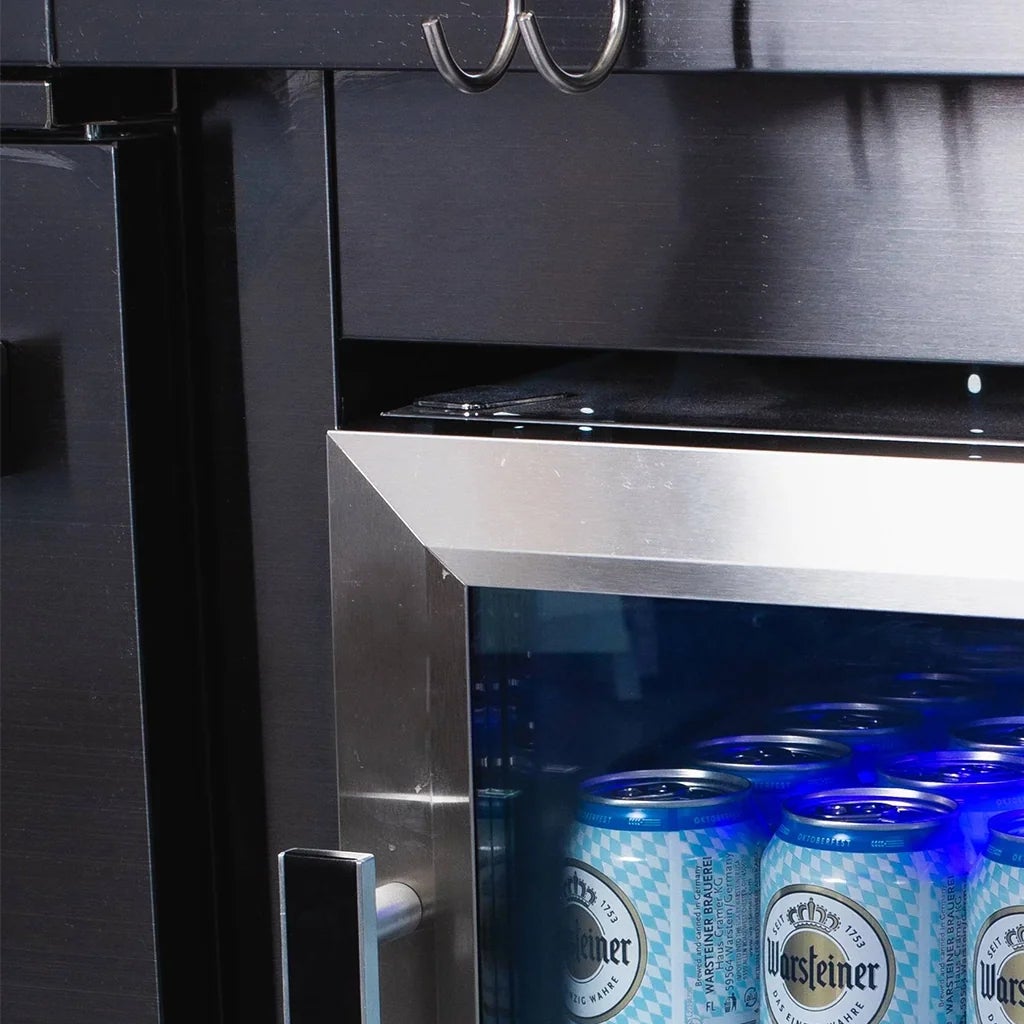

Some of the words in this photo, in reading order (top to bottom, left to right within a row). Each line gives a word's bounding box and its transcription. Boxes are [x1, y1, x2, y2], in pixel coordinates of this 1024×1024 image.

[797, 832, 852, 847] OKTOBERFEST
[703, 856, 713, 914] BRAUEREI
[713, 877, 723, 894] KG
[600, 900, 618, 923] 1753
[714, 898, 724, 938] Cramer
[723, 852, 736, 958] Warstein/Germany
[946, 875, 956, 934] BRAUEREI
[772, 914, 785, 935] SEIT
[845, 925, 866, 949] 1753
[704, 918, 715, 994] WARSTEINER
[714, 941, 724, 970] Haus
[767, 939, 881, 991] Warsteiner
[987, 938, 1002, 959] SEIT
[589, 976, 619, 1003] WAHRE
[724, 960, 735, 991] 59564
[945, 938, 955, 1014] WARSTEINER
[772, 991, 785, 1012] DAS
